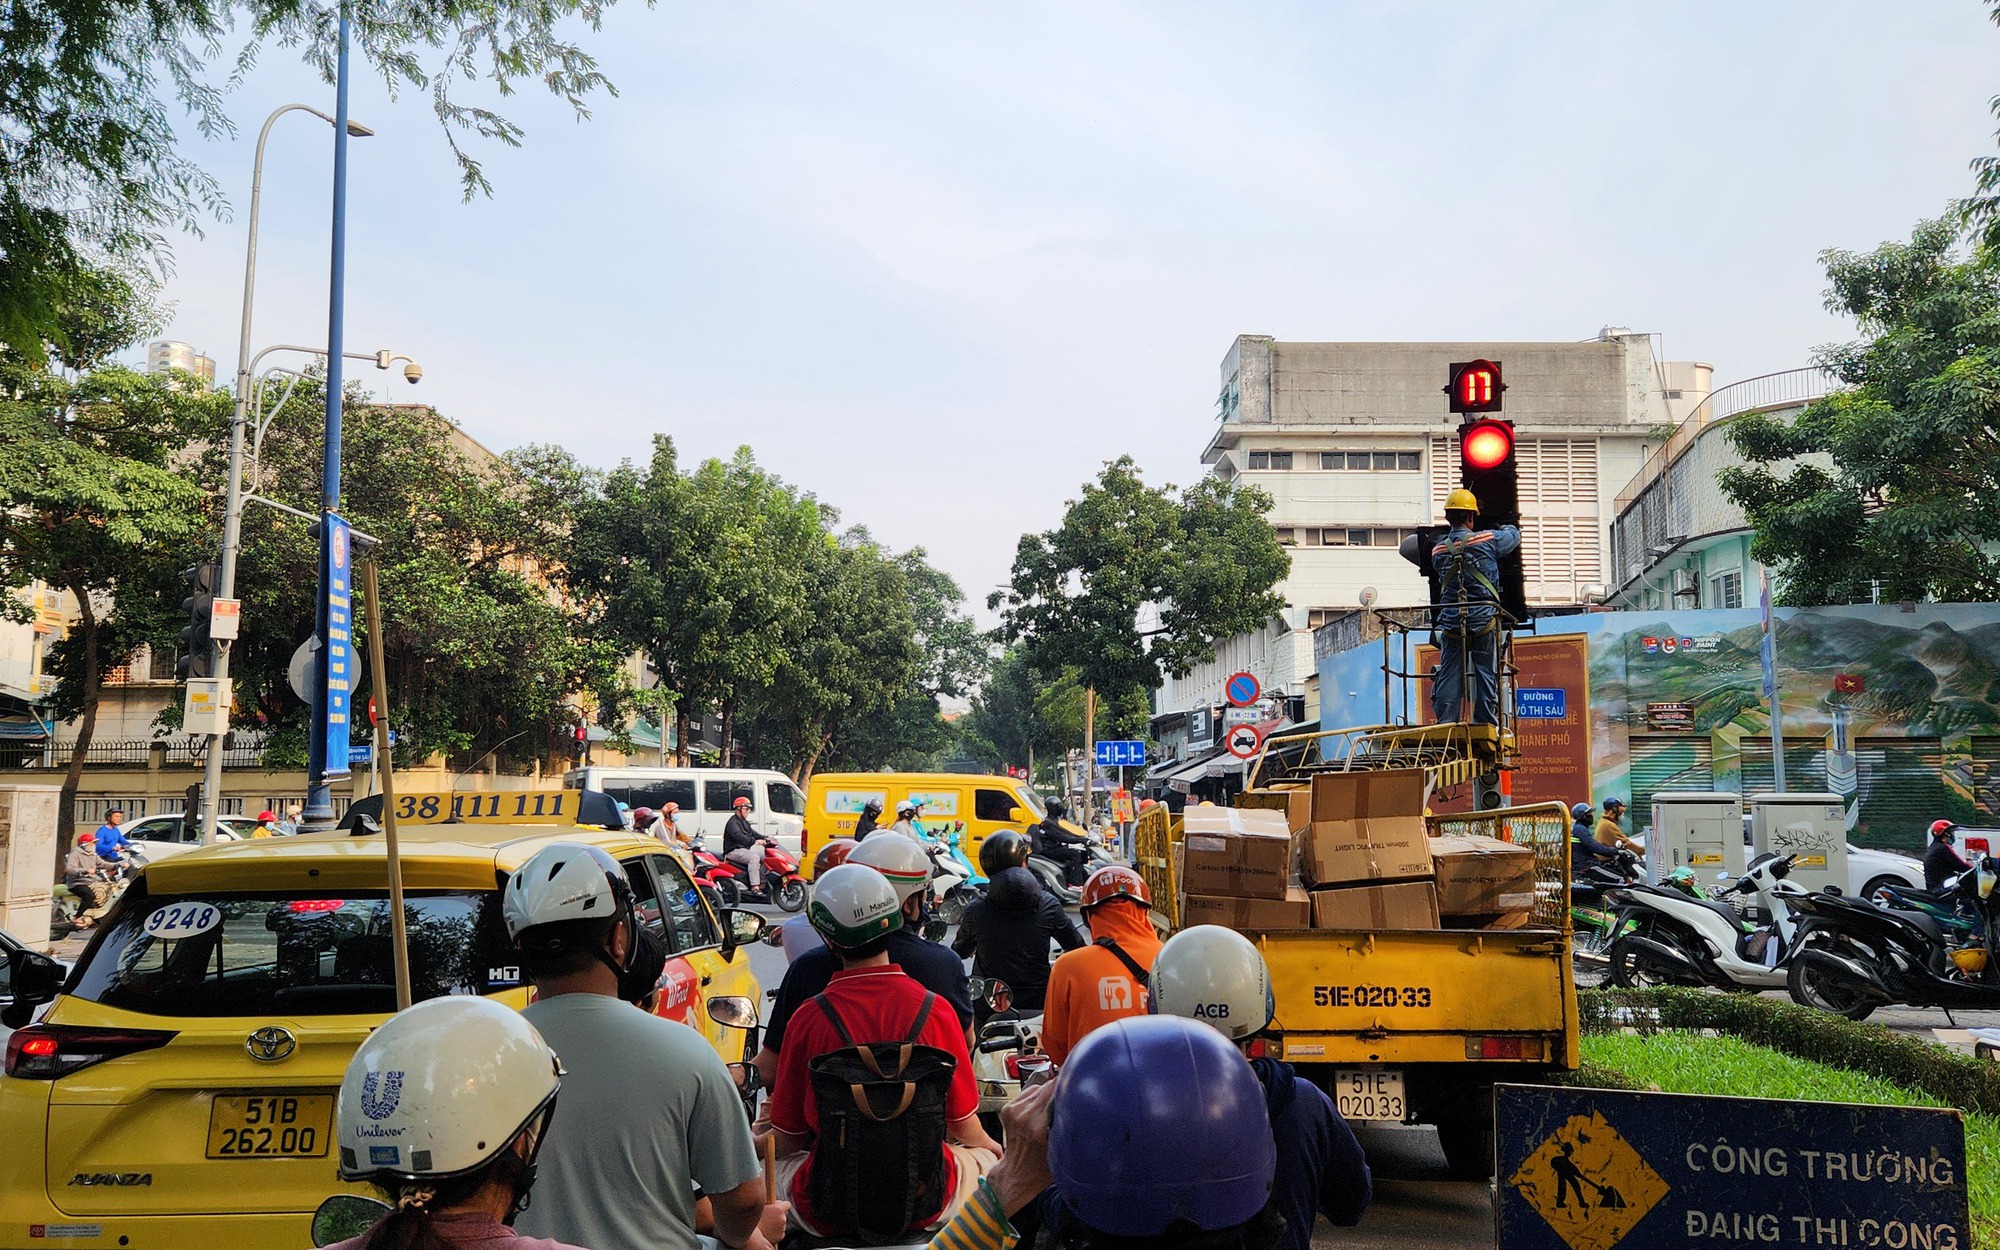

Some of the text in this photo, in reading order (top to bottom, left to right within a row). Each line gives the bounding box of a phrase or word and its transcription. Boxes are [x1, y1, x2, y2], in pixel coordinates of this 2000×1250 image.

[1467, 371, 1492, 401] 17
[1523, 691, 1555, 701] ĐƯỜNG
[1528, 705, 1543, 717] THỊ
[1545, 703, 1564, 715] SÁU
[1564, 766, 1579, 774] CITY
[395, 794, 564, 819] 38 111 111
[1335, 844, 1356, 852] LIGHT
[148, 907, 214, 931] 9248
[1193, 1003, 1230, 1018] ACB
[1352, 1073, 1388, 1094] 51E
[245, 1098, 298, 1124] 51B
[1340, 1096, 1403, 1117] 020.33
[220, 1127, 316, 1154] 262.00
[356, 1125, 406, 1138] Unilever
[1686, 1137, 1954, 1185] CÔNG TRƯỜNG
[67, 1173, 153, 1187] AVANZA
[1686, 1210, 1780, 1242] ĐANG
[1792, 1216, 1847, 1246] THI
